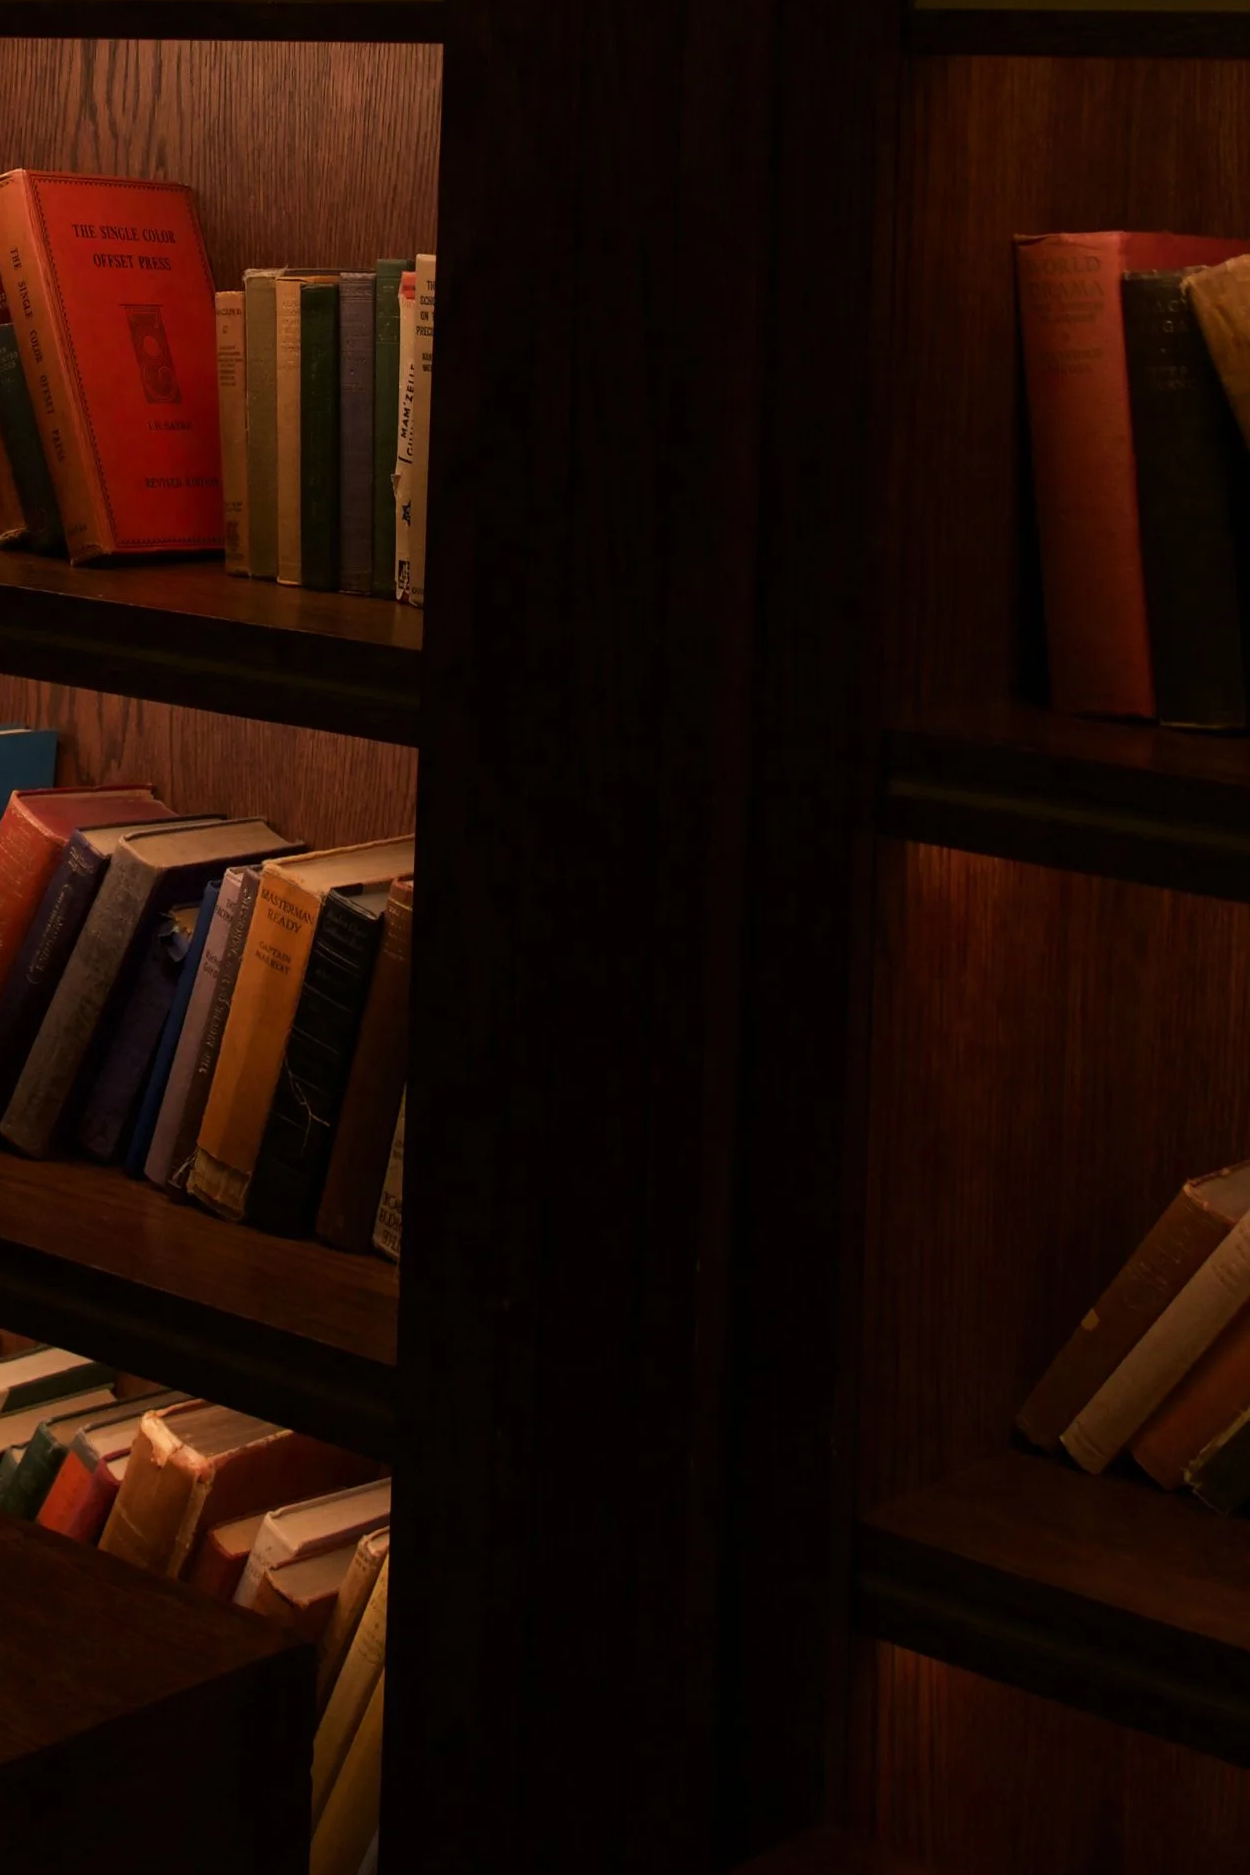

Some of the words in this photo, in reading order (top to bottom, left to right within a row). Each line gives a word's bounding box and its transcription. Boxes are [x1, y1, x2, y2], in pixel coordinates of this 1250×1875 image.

[72, 223, 97, 239] THE
[100, 225, 140, 242] SINGLE
[142, 228, 176, 244] COLOR
[93, 252, 135, 269] OFFSET
[138, 254, 172, 271] PRESS
[10, 246, 23, 271] THE
[17, 280, 35, 319] SINGLE
[28, 329, 43, 365] COLOR
[40, 374, 56, 416] OFFSET
[52, 428, 67, 463] PRESS
[145, 477, 182, 489] REVISED
[261, 888, 315, 925] MASTERMAN
[267, 908, 303, 935] READY
